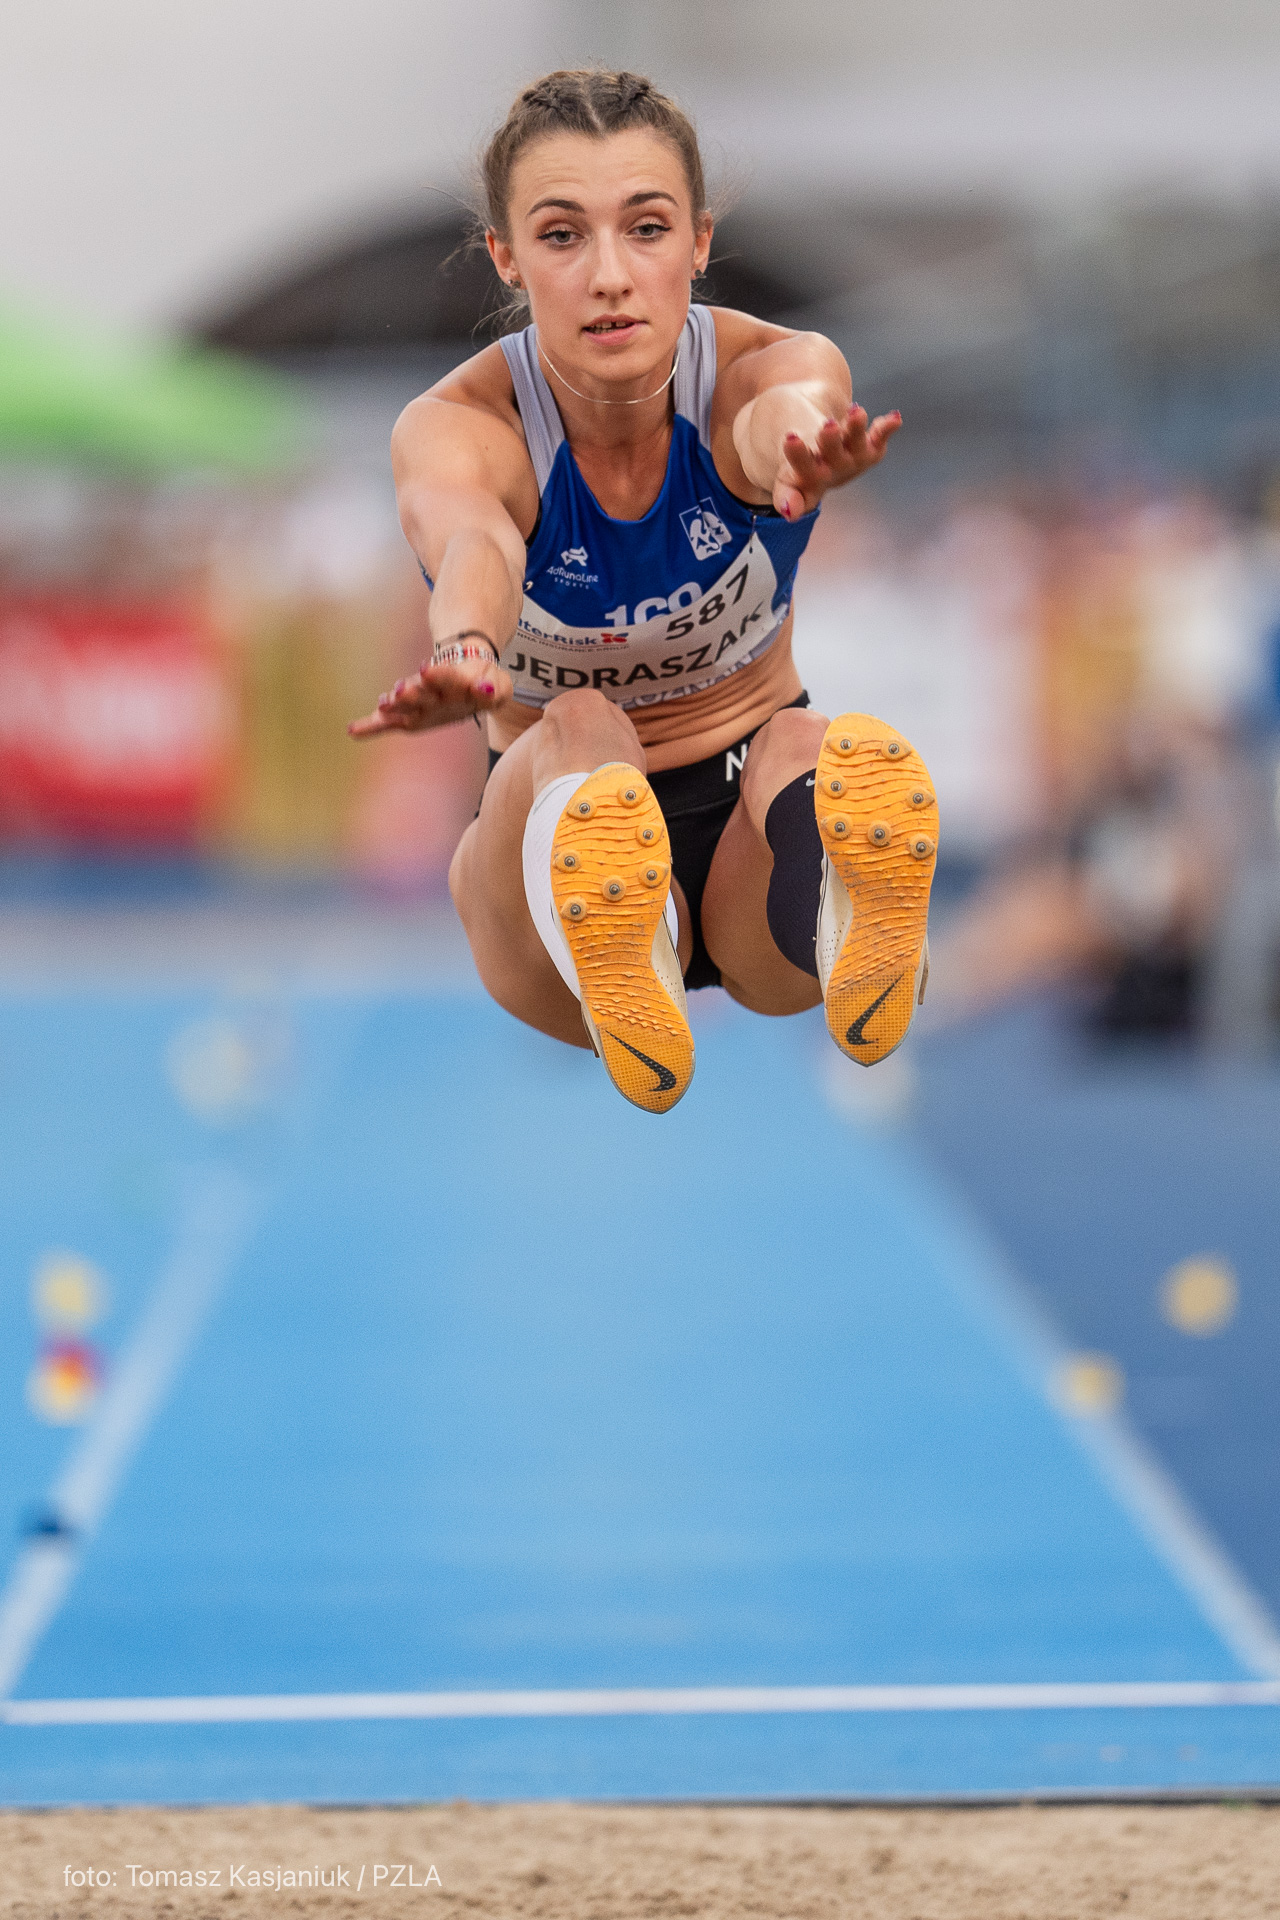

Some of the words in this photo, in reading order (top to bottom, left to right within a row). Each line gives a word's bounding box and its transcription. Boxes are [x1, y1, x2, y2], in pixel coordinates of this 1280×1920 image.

[518, 617, 598, 646] terRisk
[665, 562, 749, 641] 587
[508, 600, 764, 689] JĘDRASZAK
